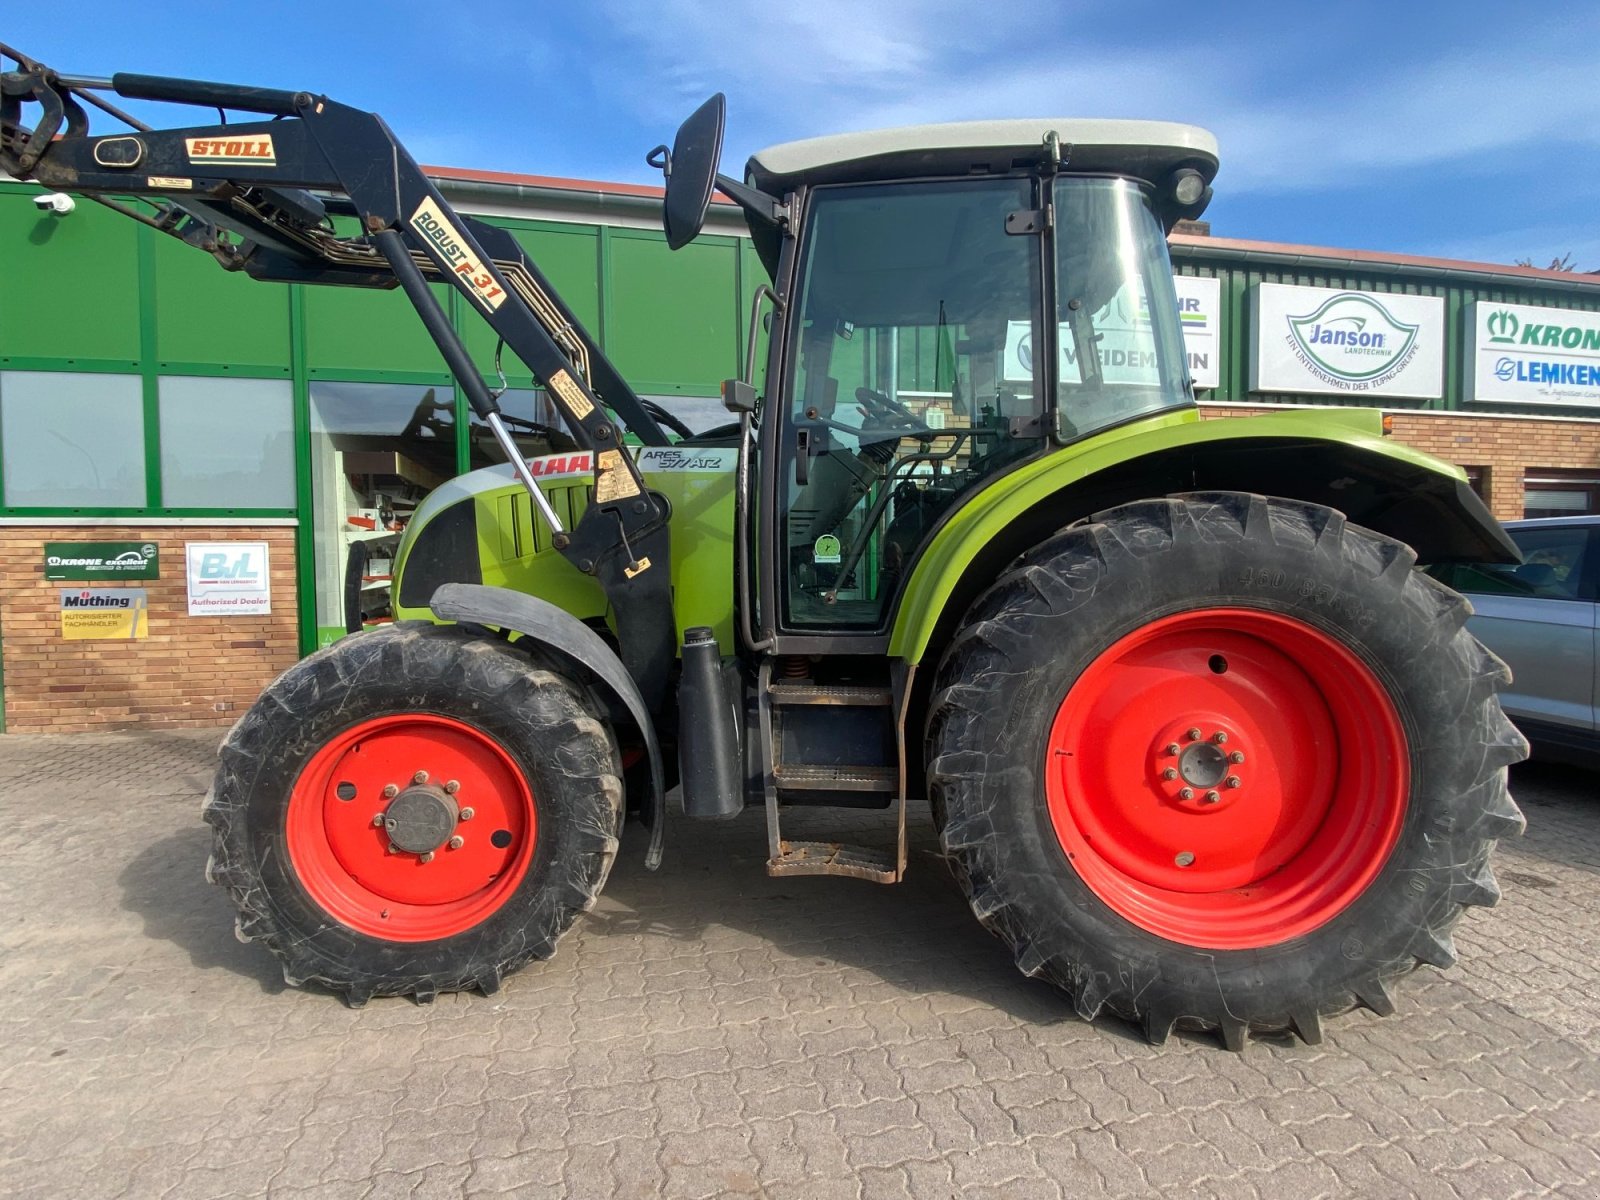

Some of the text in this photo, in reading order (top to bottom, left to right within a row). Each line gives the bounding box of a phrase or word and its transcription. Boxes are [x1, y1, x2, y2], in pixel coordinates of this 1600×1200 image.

[191, 140, 271, 157] STOLL
[417, 211, 468, 262] ROBUST
[1309, 324, 1384, 348] Janson
[1063, 347, 1209, 370] WIDEMN
[1344, 347, 1392, 357] LANDTECHNIK
[1285, 334, 1298, 351] EIN
[1295, 350, 1351, 391] UNTERNEHMEN
[1352, 382, 1369, 391] DER
[1516, 360, 1600, 387] LEMKEN
[643, 451, 682, 460] ARES
[514, 455, 594, 479] LAA
[61, 558, 148, 566] KRONE excellent
[64, 591, 130, 608] Müthing
[191, 598, 238, 606] Authorized
[64, 620, 118, 628] FACHHÄNDLER
